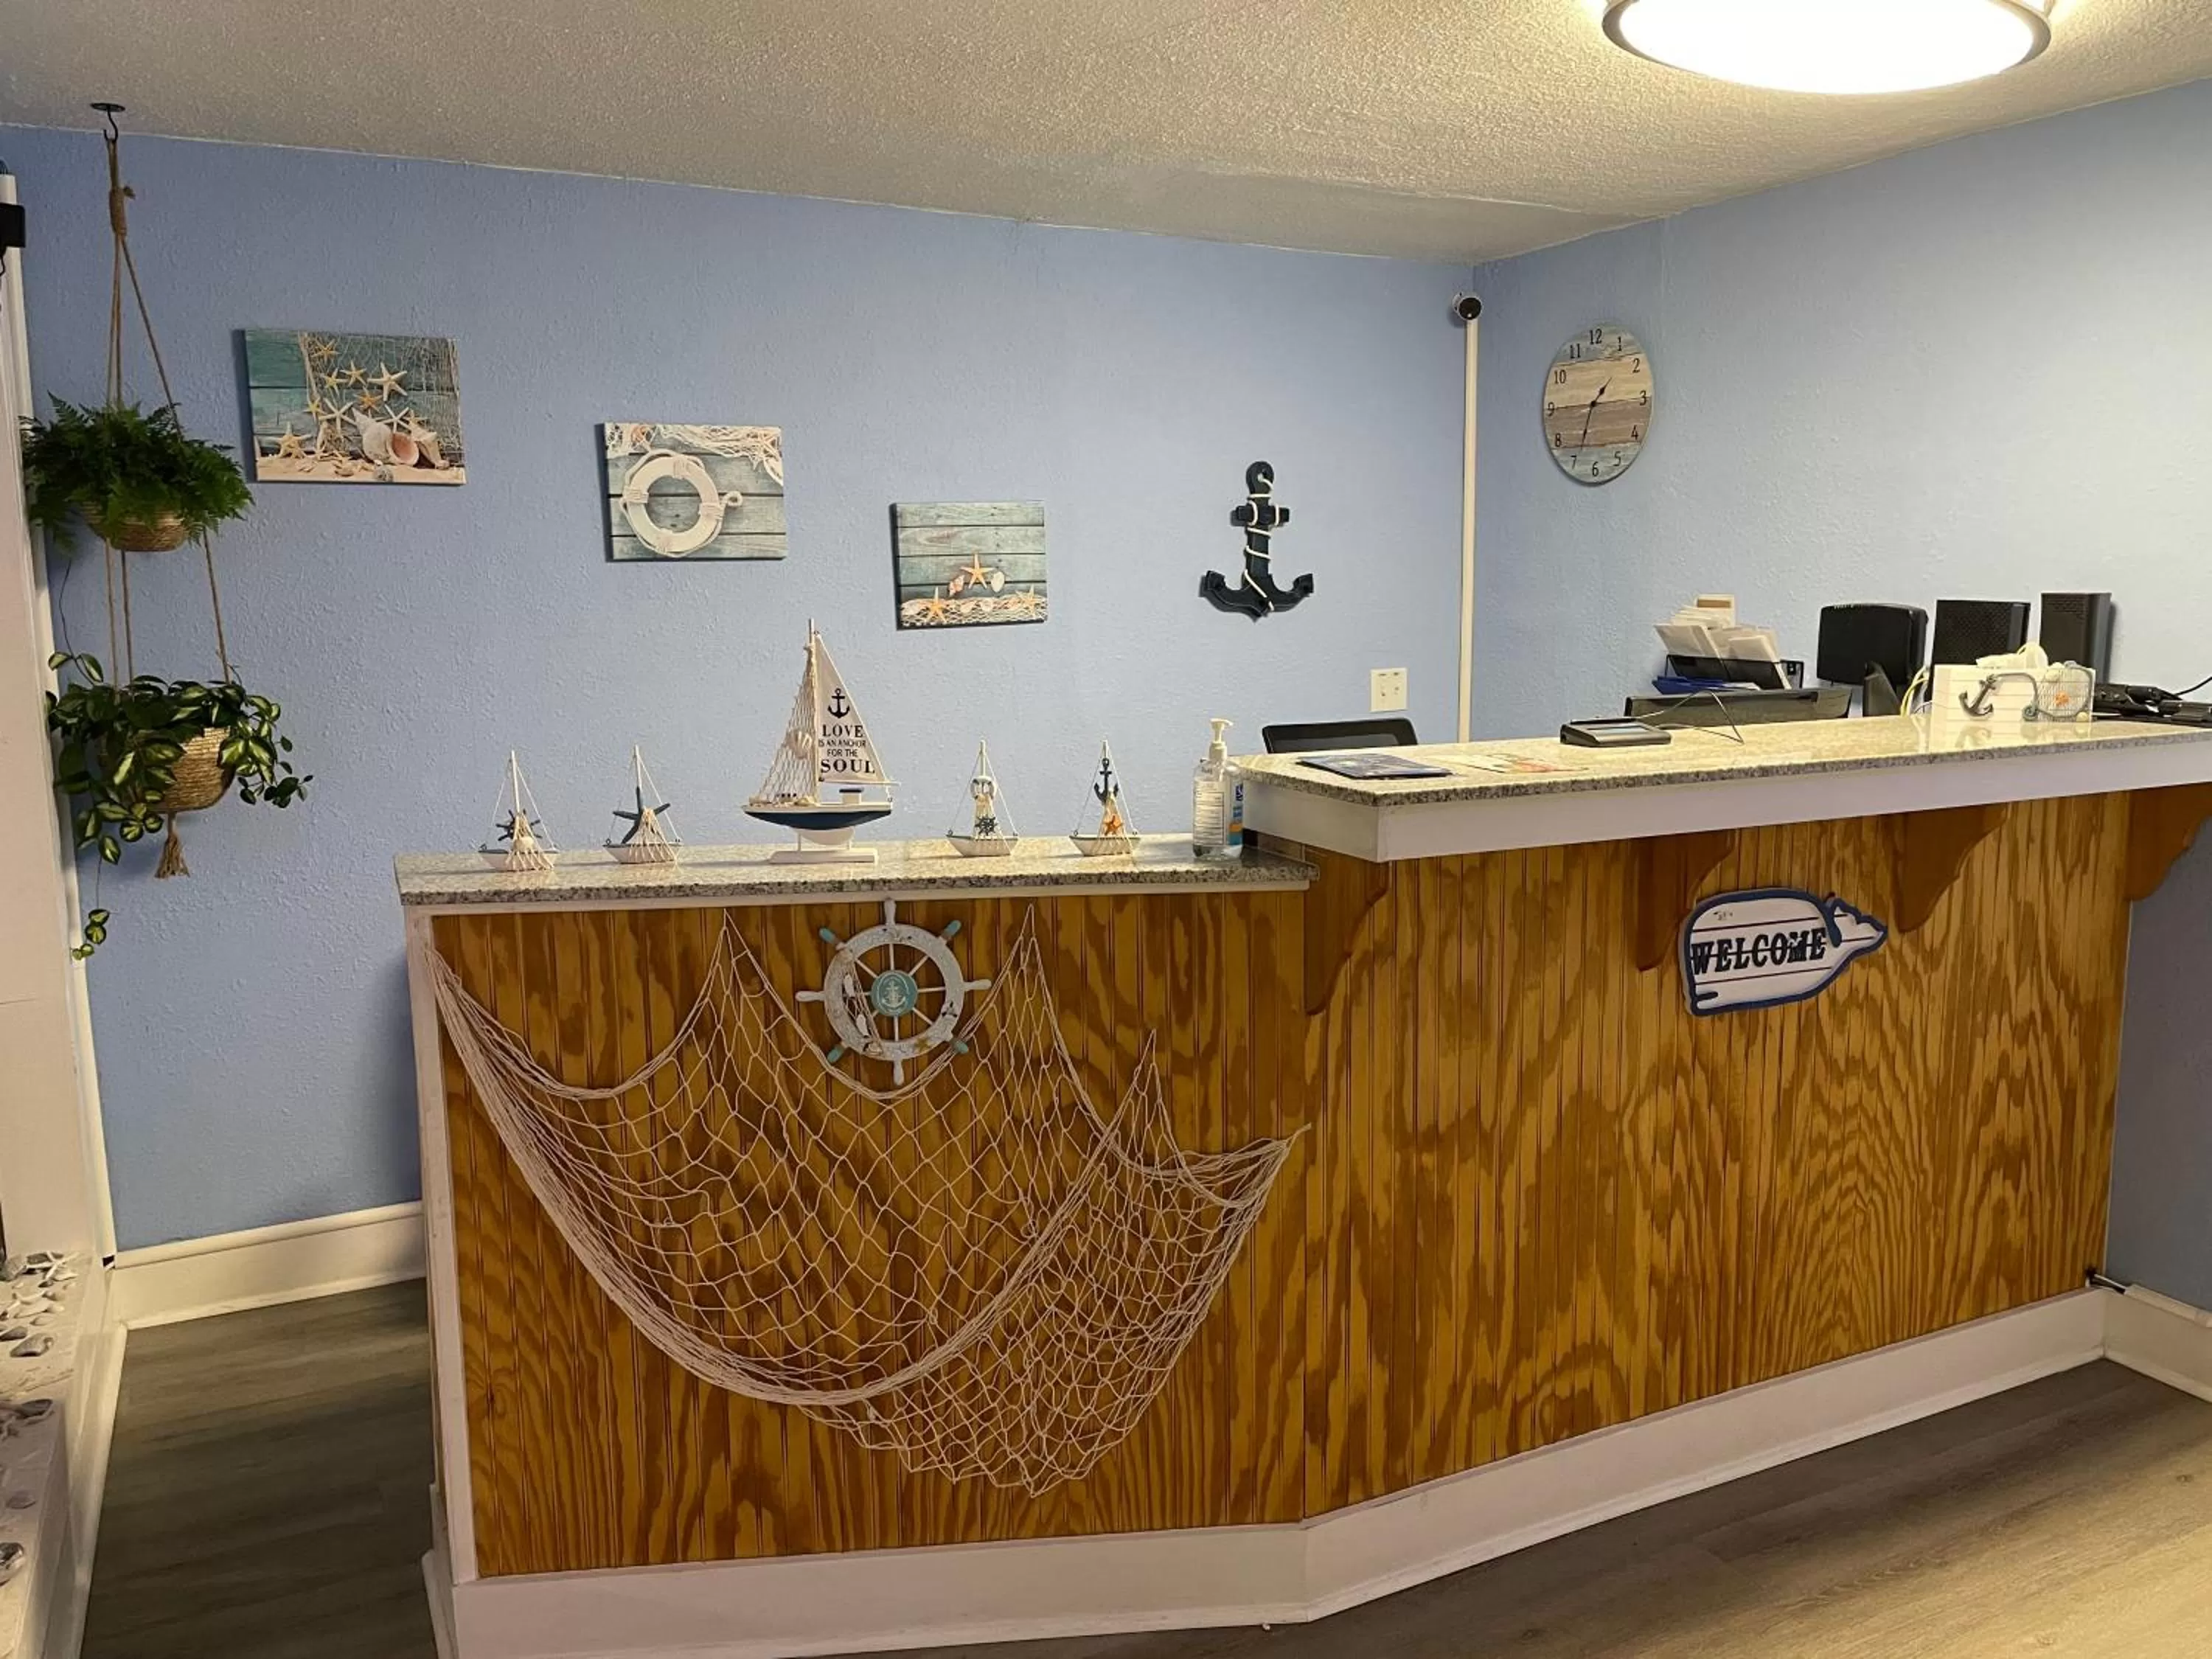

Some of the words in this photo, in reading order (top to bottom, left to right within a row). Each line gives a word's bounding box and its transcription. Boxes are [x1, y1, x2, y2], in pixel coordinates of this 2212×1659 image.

[1589, 329, 1602, 344] 12
[1617, 336, 1623, 352] 1
[1570, 344, 1581, 359] 11
[1632, 358, 1641, 373] 2
[1554, 369, 1566, 384] 10
[1639, 390, 1647, 406] 3
[1548, 402, 1555, 417] 9
[1631, 425, 1638, 440] 4
[1555, 434, 1562, 447] 8
[1571, 456, 1577, 469] 7
[1613, 451, 1621, 467] 5
[1592, 462, 1599, 476] 6
[822, 724, 863, 737] LOVE
[838, 740, 866, 748] ANCHOR
[827, 748, 843, 757] FOR
[844, 748, 858, 757] THE
[821, 759, 875, 773] SOUL
[1691, 927, 1827, 975] WELCOME
